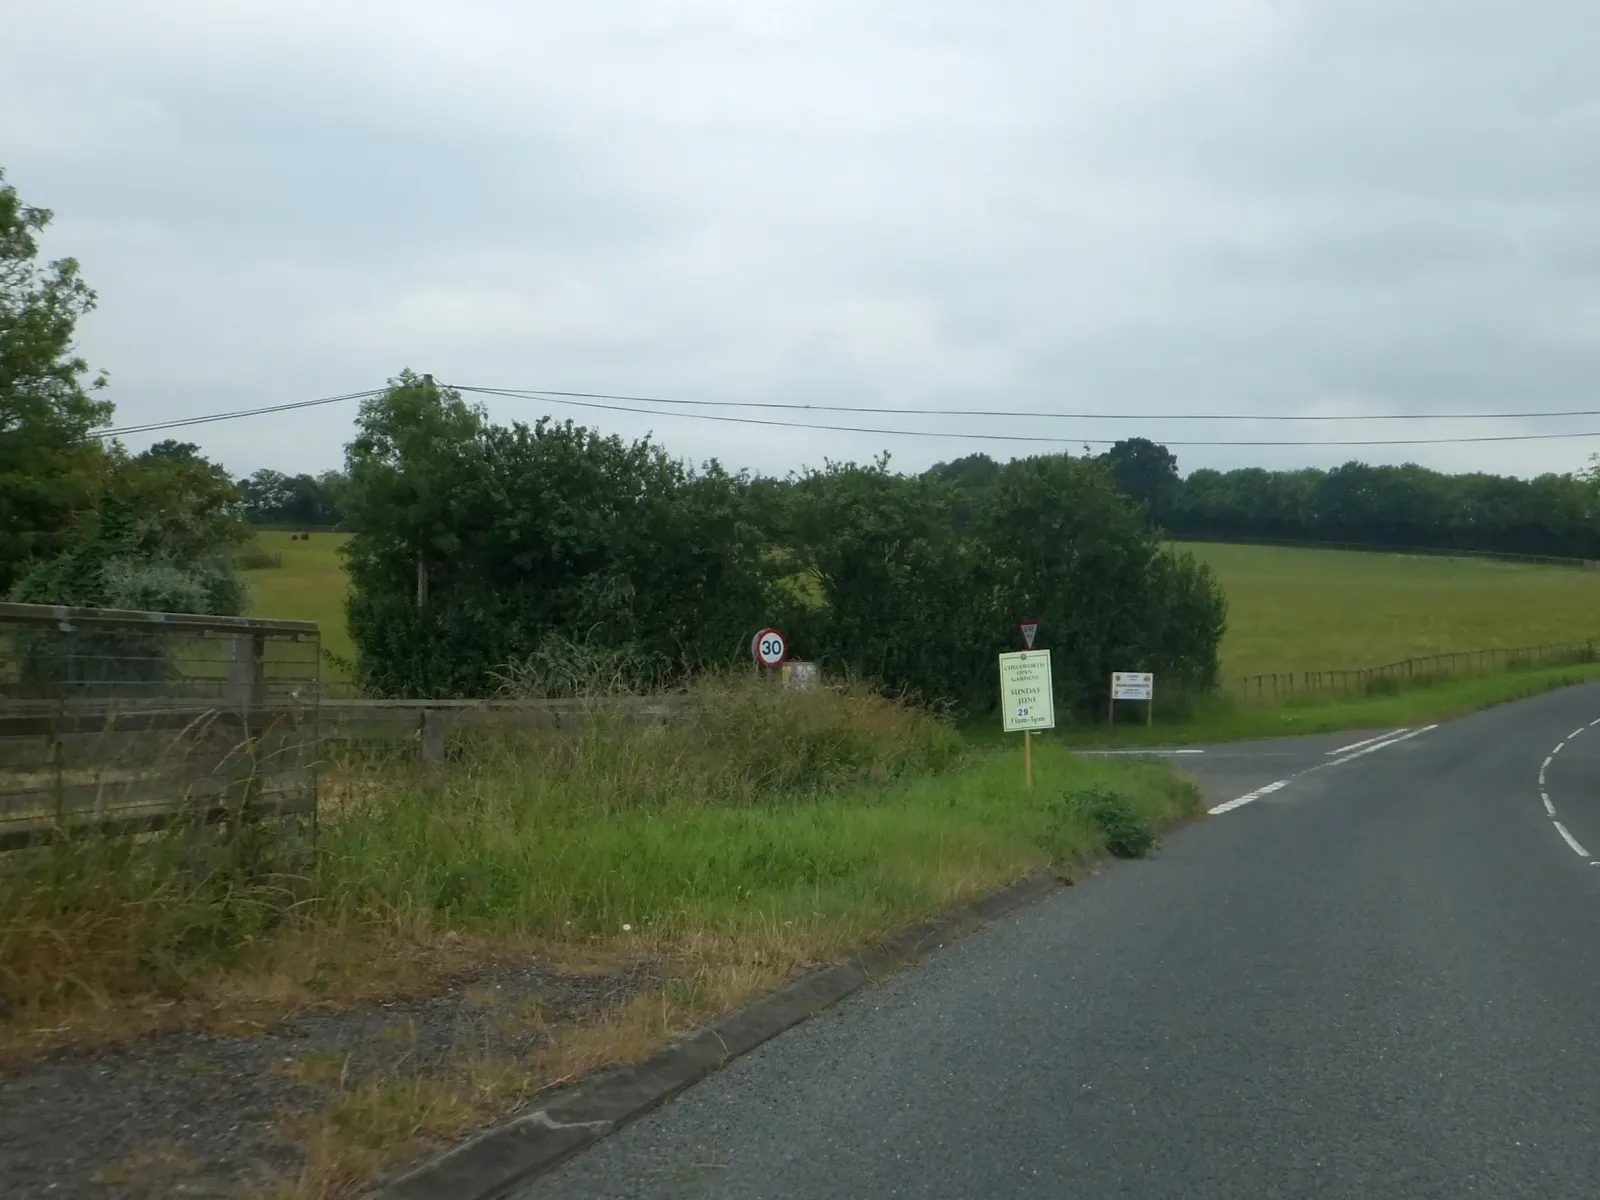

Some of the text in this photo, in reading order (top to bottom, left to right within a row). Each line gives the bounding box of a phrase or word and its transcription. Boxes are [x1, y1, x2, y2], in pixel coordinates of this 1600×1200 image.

[762, 640, 781, 655] 30
[1010, 687, 1041, 696] SUNDAY
[1018, 697, 1036, 705] JUNE
[1018, 708, 1029, 717] 29
